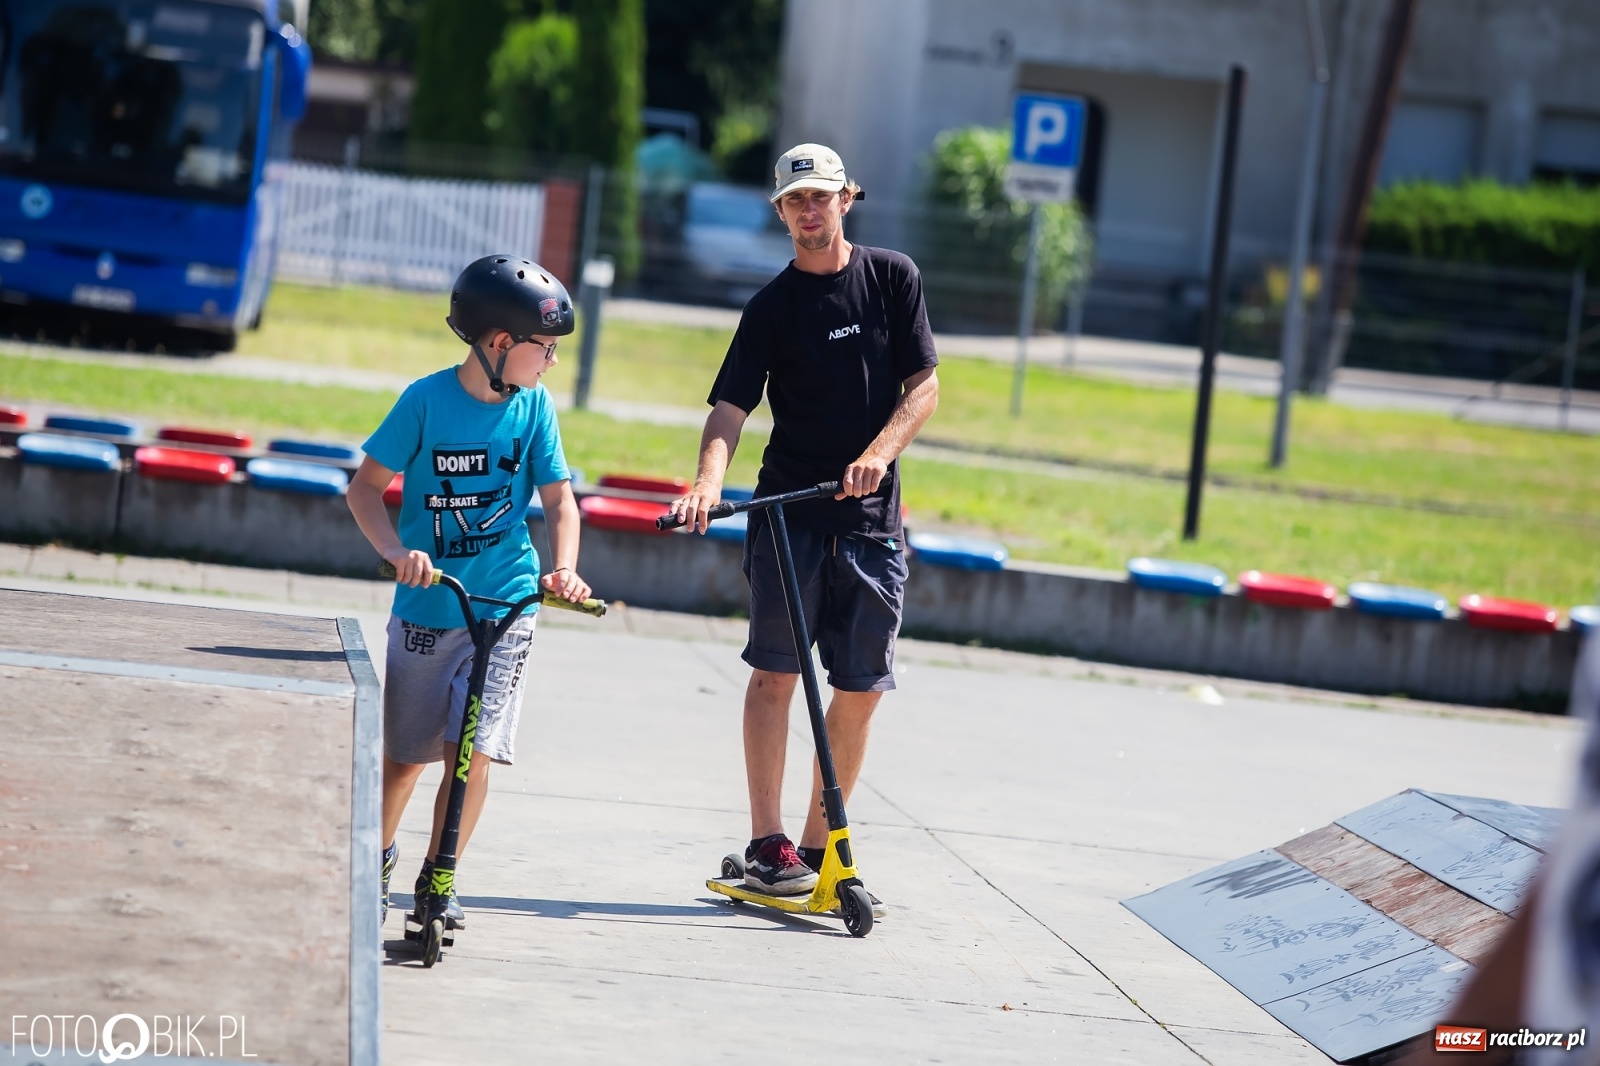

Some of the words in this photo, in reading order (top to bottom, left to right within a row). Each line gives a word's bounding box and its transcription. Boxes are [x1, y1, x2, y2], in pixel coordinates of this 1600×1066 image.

[1024, 101, 1069, 156] P
[828, 324, 861, 341] ABOVE
[436, 454, 485, 472] DON'T
[449, 496, 478, 508] SKATE
[456, 694, 481, 784] RAVEN
